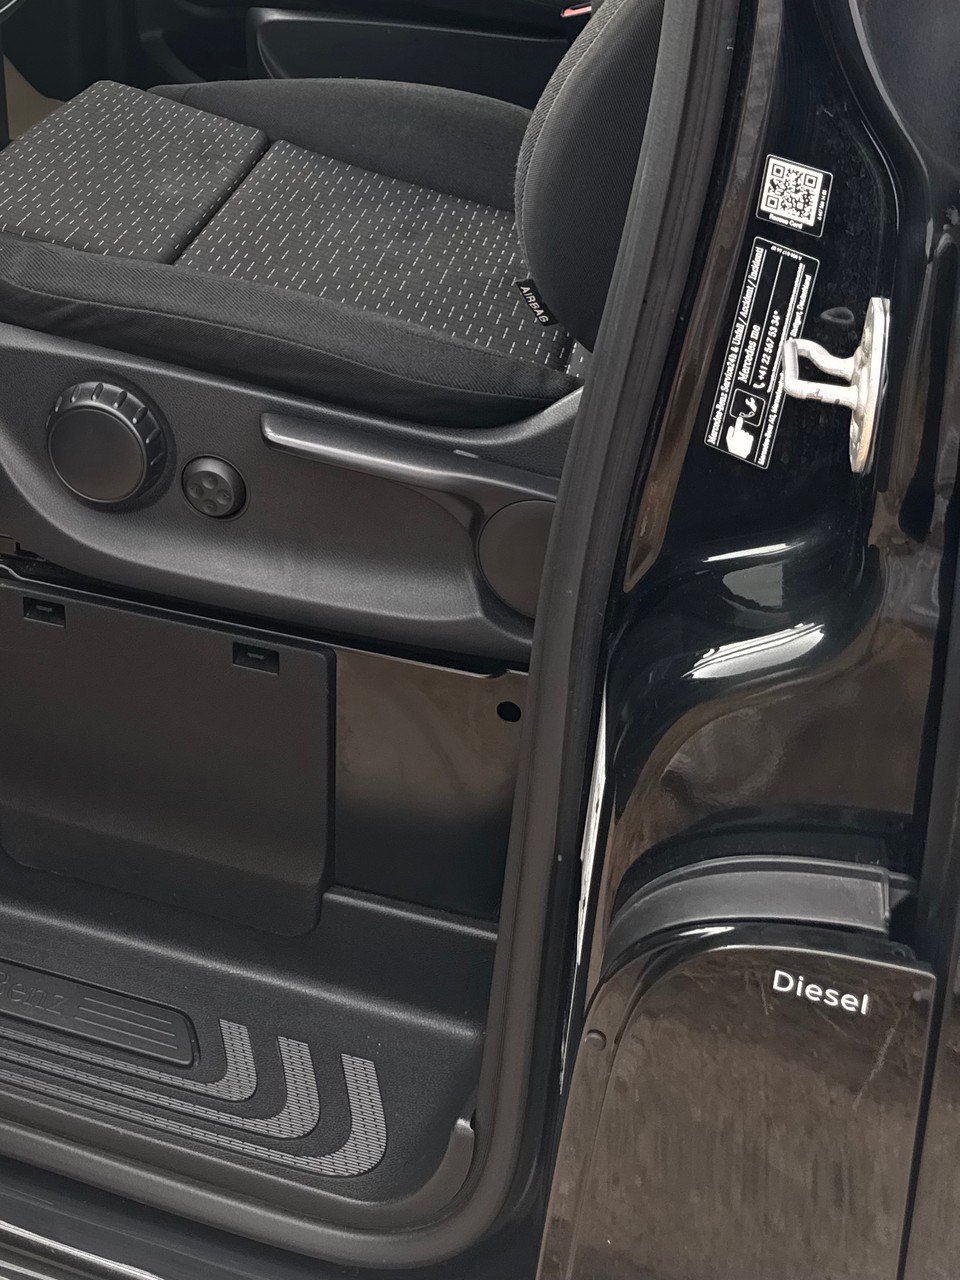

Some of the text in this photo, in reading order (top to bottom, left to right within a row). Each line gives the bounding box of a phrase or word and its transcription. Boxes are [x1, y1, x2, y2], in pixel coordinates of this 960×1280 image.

[747, 246, 764, 281] Incidenti
[520, 286, 549, 323] AIRBAG
[739, 285, 755, 319] Accident
[731, 323, 745, 345] Unfall
[731, 344, 740, 353] &
[764, 339, 775, 354] 567
[767, 326, 778, 339] 53
[737, 324, 761, 384] Mercedes me
[761, 354, 772, 366] 22
[720, 352, 738, 393] Service24h
[757, 365, 769, 381] +41
[706, 392, 728, 445] Mercedes-Benz
[772, 969, 869, 1015] Diesel
